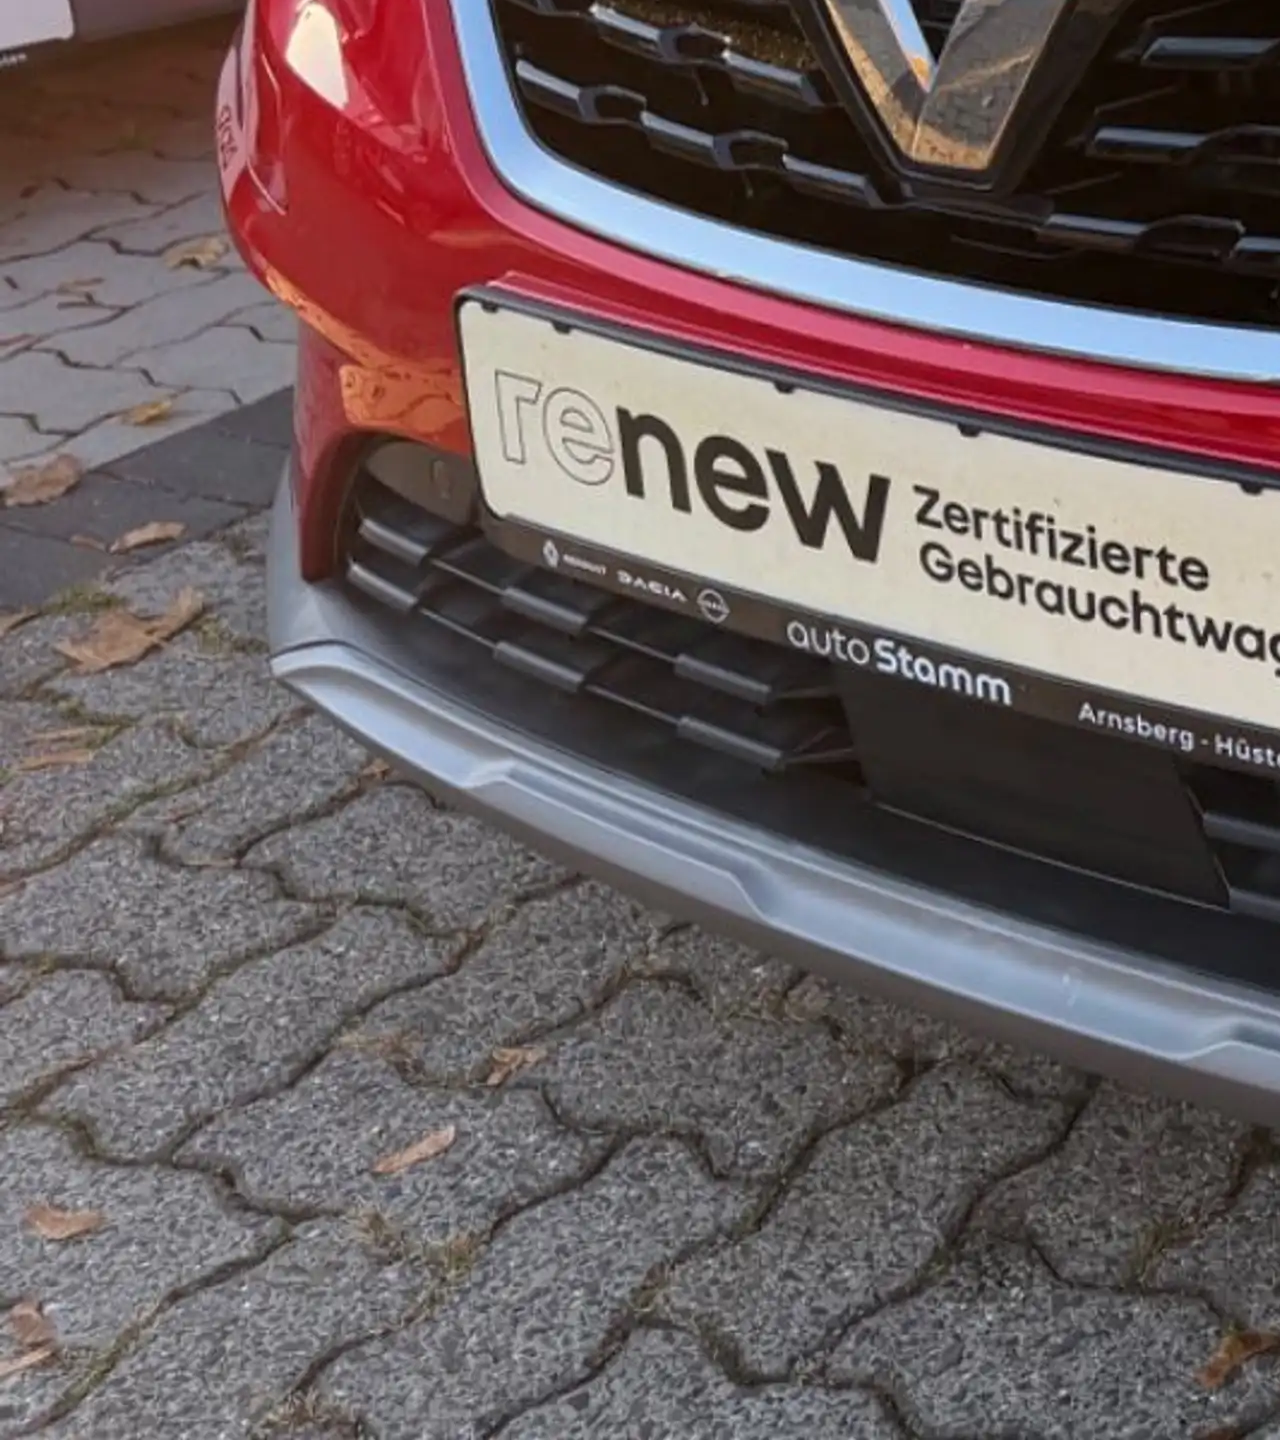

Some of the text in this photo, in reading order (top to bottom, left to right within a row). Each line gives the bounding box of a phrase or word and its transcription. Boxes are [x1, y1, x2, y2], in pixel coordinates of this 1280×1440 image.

[494, 369, 892, 565] renew
[913, 485, 1210, 592] Zertifizierte
[616, 569, 689, 603] DACIA
[1078, 700, 1195, 753] Arnsberg
